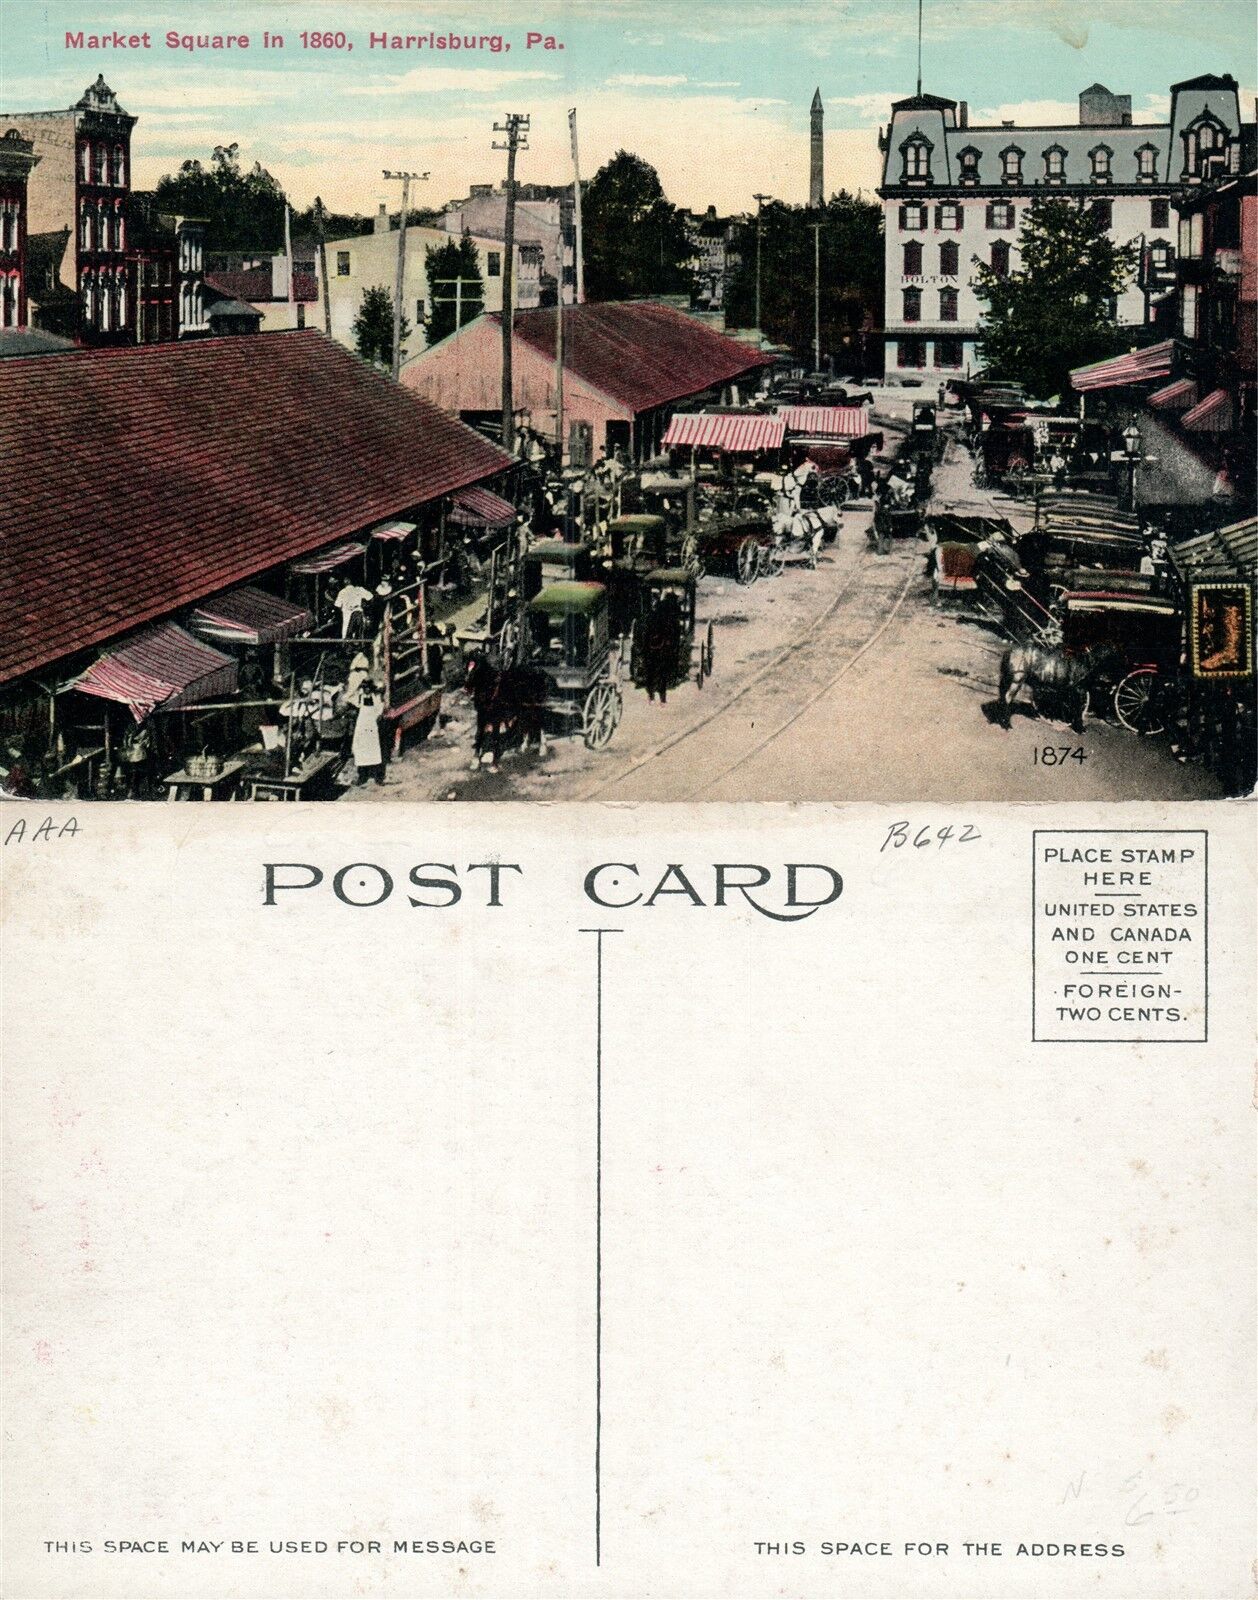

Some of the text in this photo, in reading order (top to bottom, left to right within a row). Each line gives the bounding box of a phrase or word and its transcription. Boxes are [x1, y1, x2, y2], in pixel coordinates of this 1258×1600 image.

[880, 821, 982, 853] B642
[1044, 847, 1196, 864] PLACE STAMP
[1084, 871, 1153, 886] HERE
[262, 862, 845, 922] POST CARD
[1044, 903, 1198, 917] UNITED STATES
[1051, 927, 1193, 942] AND CANADA
[1065, 950, 1174, 964] ONE CENT
[1063, 984, 1183, 999] FOREIGN-
[1056, 1007, 1188, 1022] TWO CENTS.
[44, 1540, 496, 1554] THIS SPACE MAY BE USED FOR MESSAGE
[754, 1541, 1126, 1558] THIS SPACE FOR THE ADDRESS
